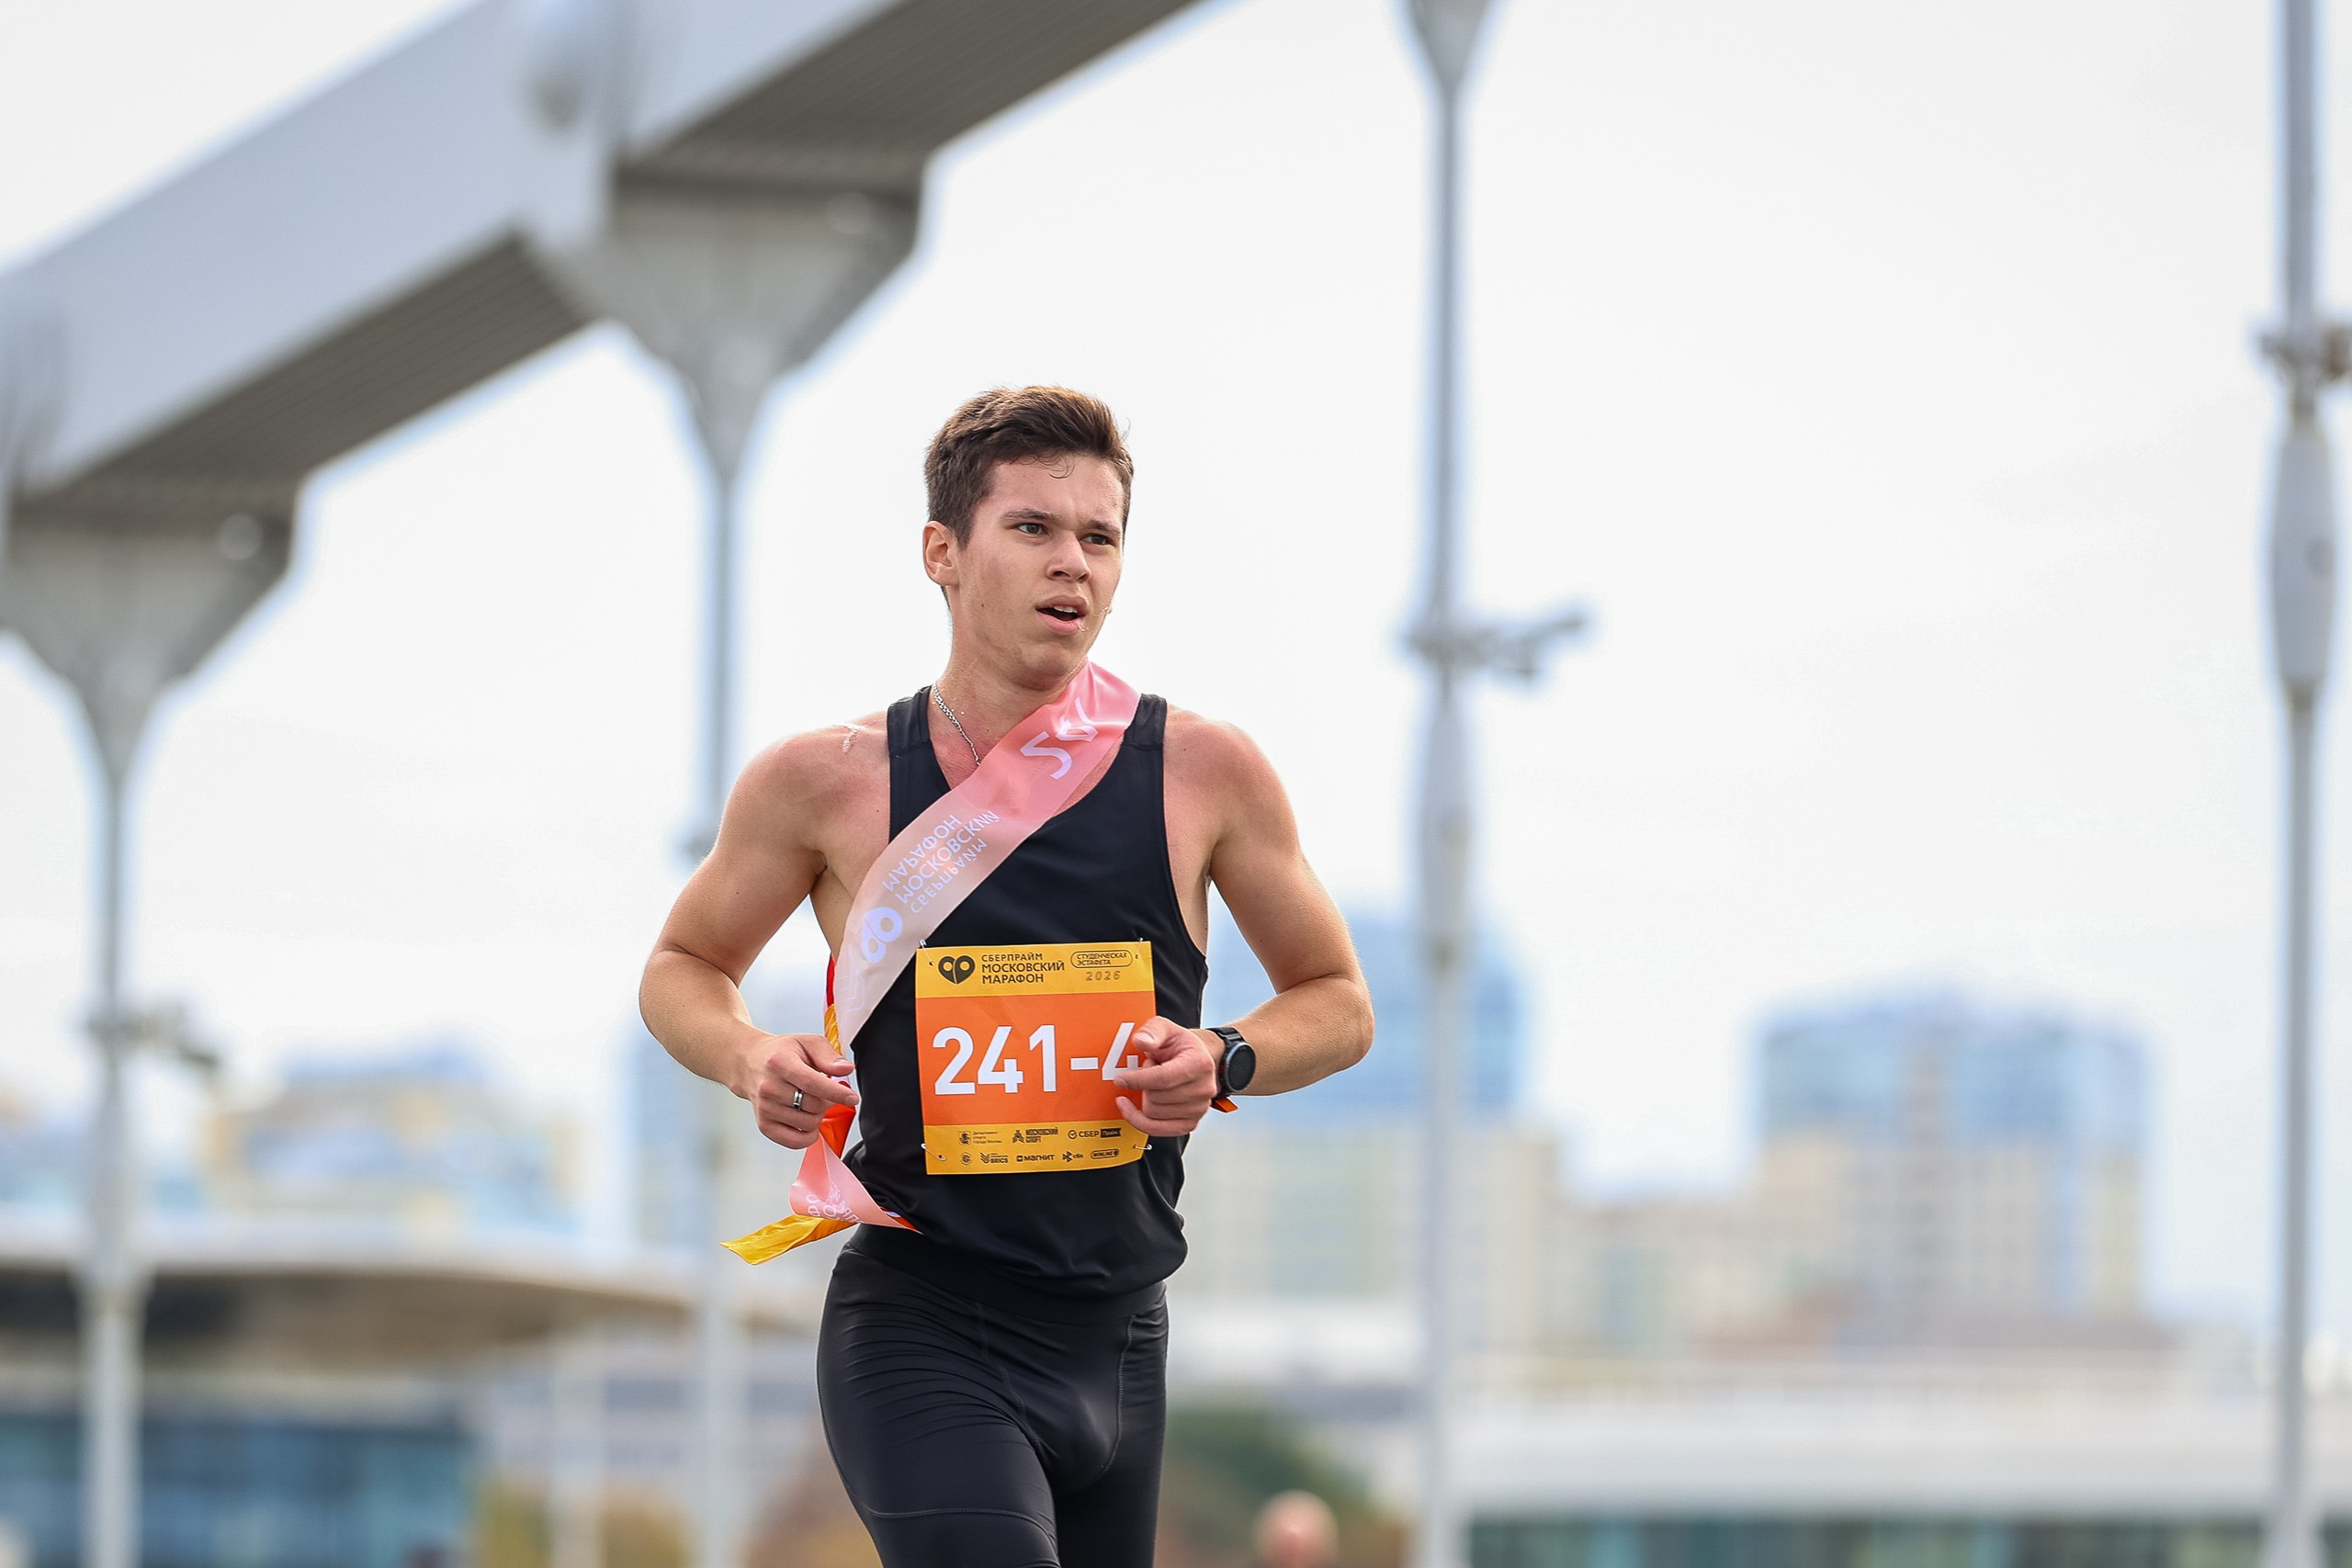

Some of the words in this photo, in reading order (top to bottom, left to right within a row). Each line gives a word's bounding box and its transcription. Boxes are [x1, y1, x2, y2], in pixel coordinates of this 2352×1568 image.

[981, 953, 1043, 962] СБЕРПРАЙМ
[982, 960, 1065, 973] МОСКОВСКИЙ
[982, 974, 1045, 984] МАРАФОН
[1085, 970, 1121, 981] 2026
[932, 1021, 1144, 1096] 241-4
[1079, 1130, 1100, 1138] СБЕР
